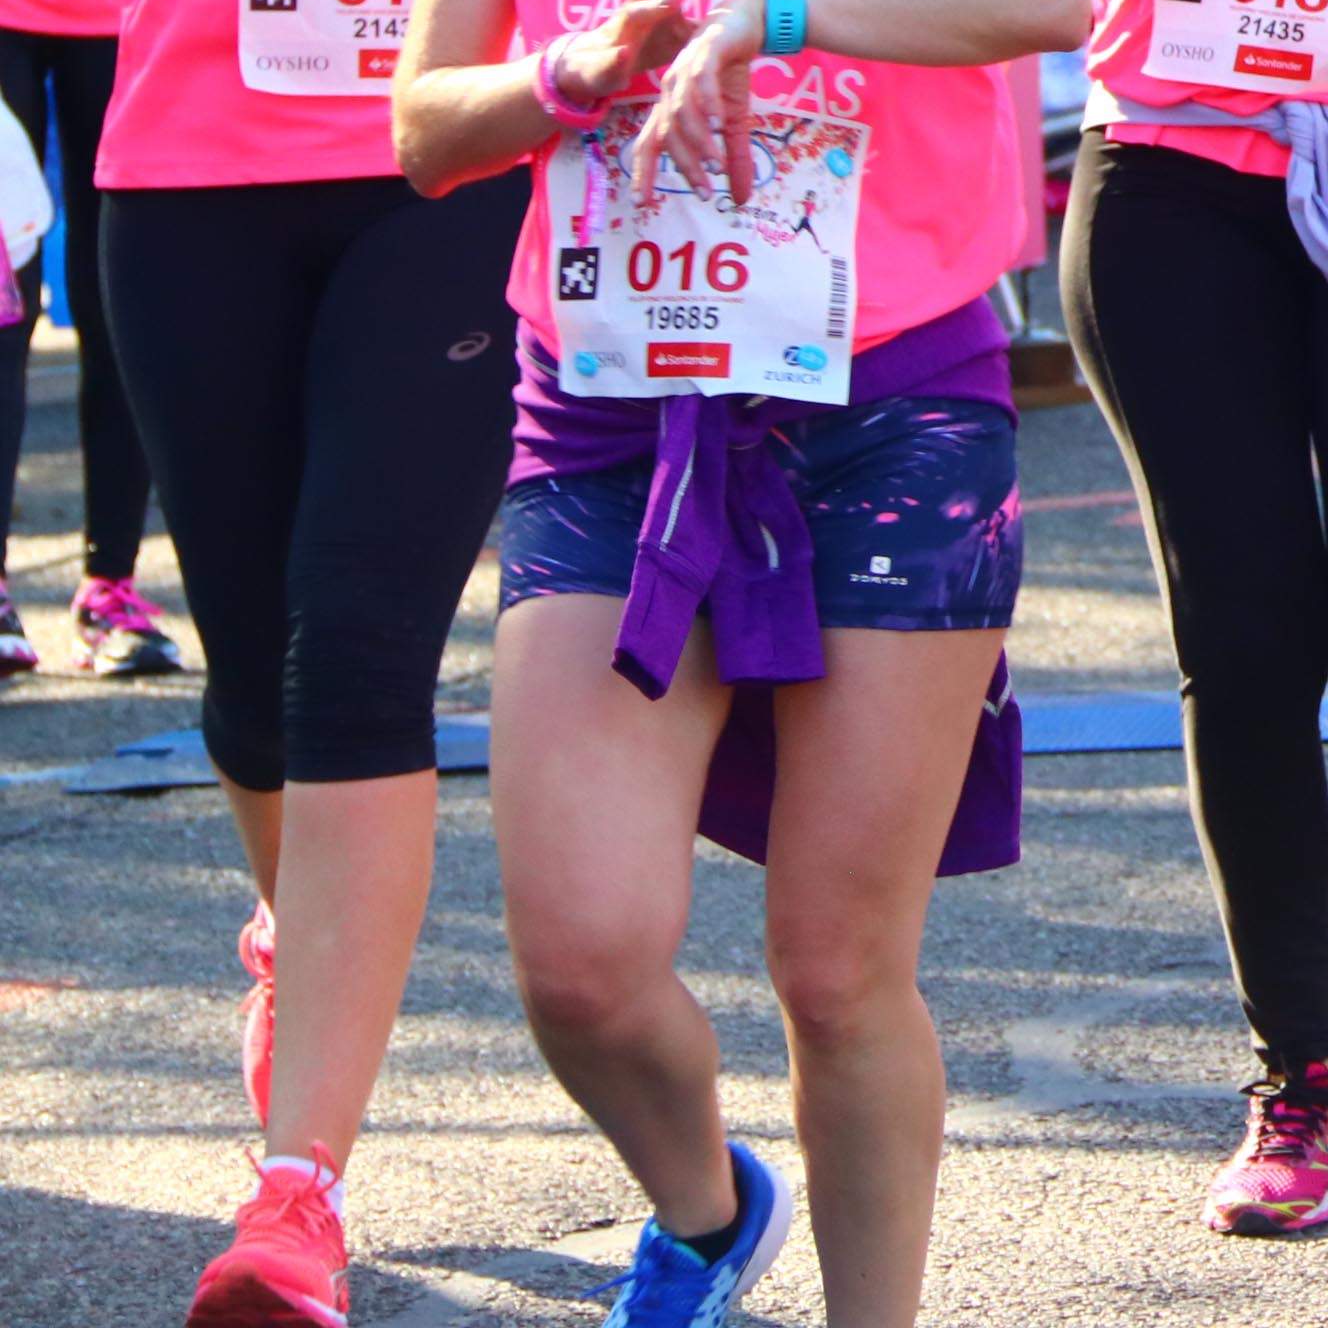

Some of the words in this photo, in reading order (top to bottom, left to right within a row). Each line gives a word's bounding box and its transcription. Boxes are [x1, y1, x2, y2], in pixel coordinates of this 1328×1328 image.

[1237, 15, 1306, 43] 21435
[1161, 42, 1214, 63] OYSHO
[256, 55, 330, 72] OYSHO
[1255, 55, 1303, 72] Santander
[626, 240, 750, 293] 016
[645, 306, 720, 330] 19685
[668, 355, 719, 366] Santander
[763, 370, 822, 385] ZURICH
